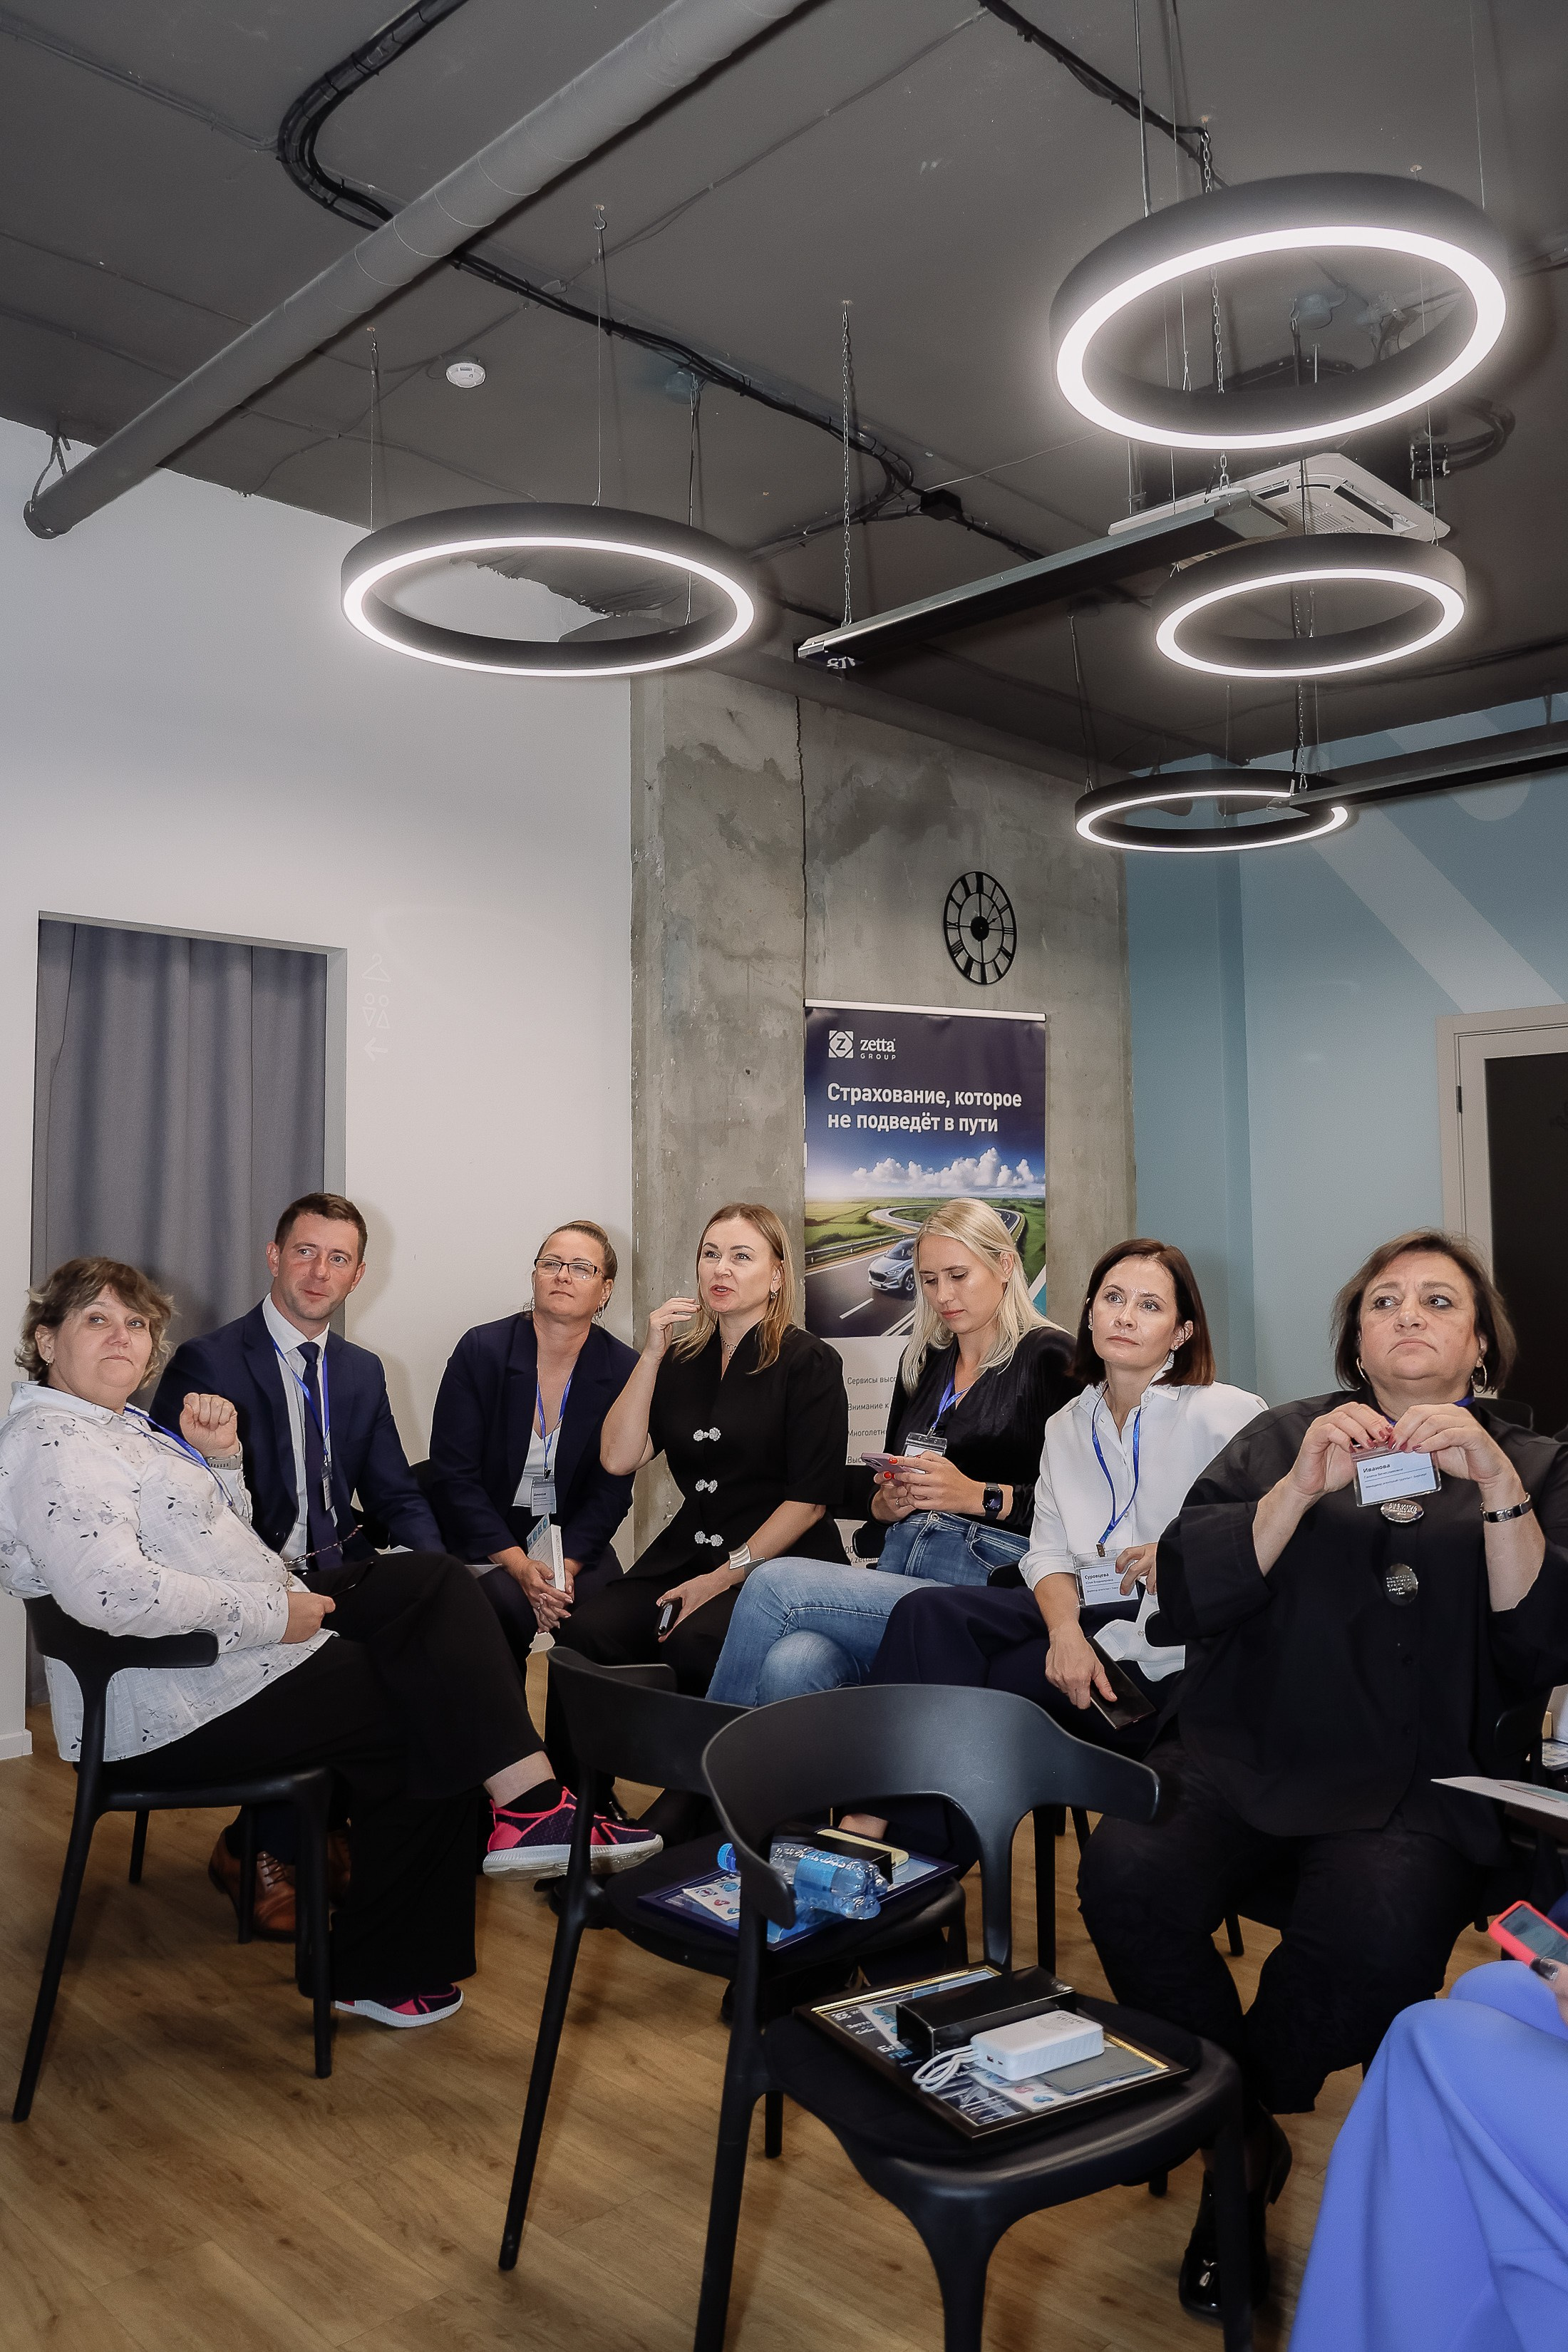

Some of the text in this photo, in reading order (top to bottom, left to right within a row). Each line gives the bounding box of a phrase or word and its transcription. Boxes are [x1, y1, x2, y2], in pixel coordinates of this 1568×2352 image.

[860, 1038, 896, 1053] zetta
[827, 1083, 1022, 1110] Страхование, которое
[827, 1112, 998, 1135] не подведёт в пути
[847, 1377, 878, 1386] Сервисы
[1363, 1464, 1391, 1472] Иванова
